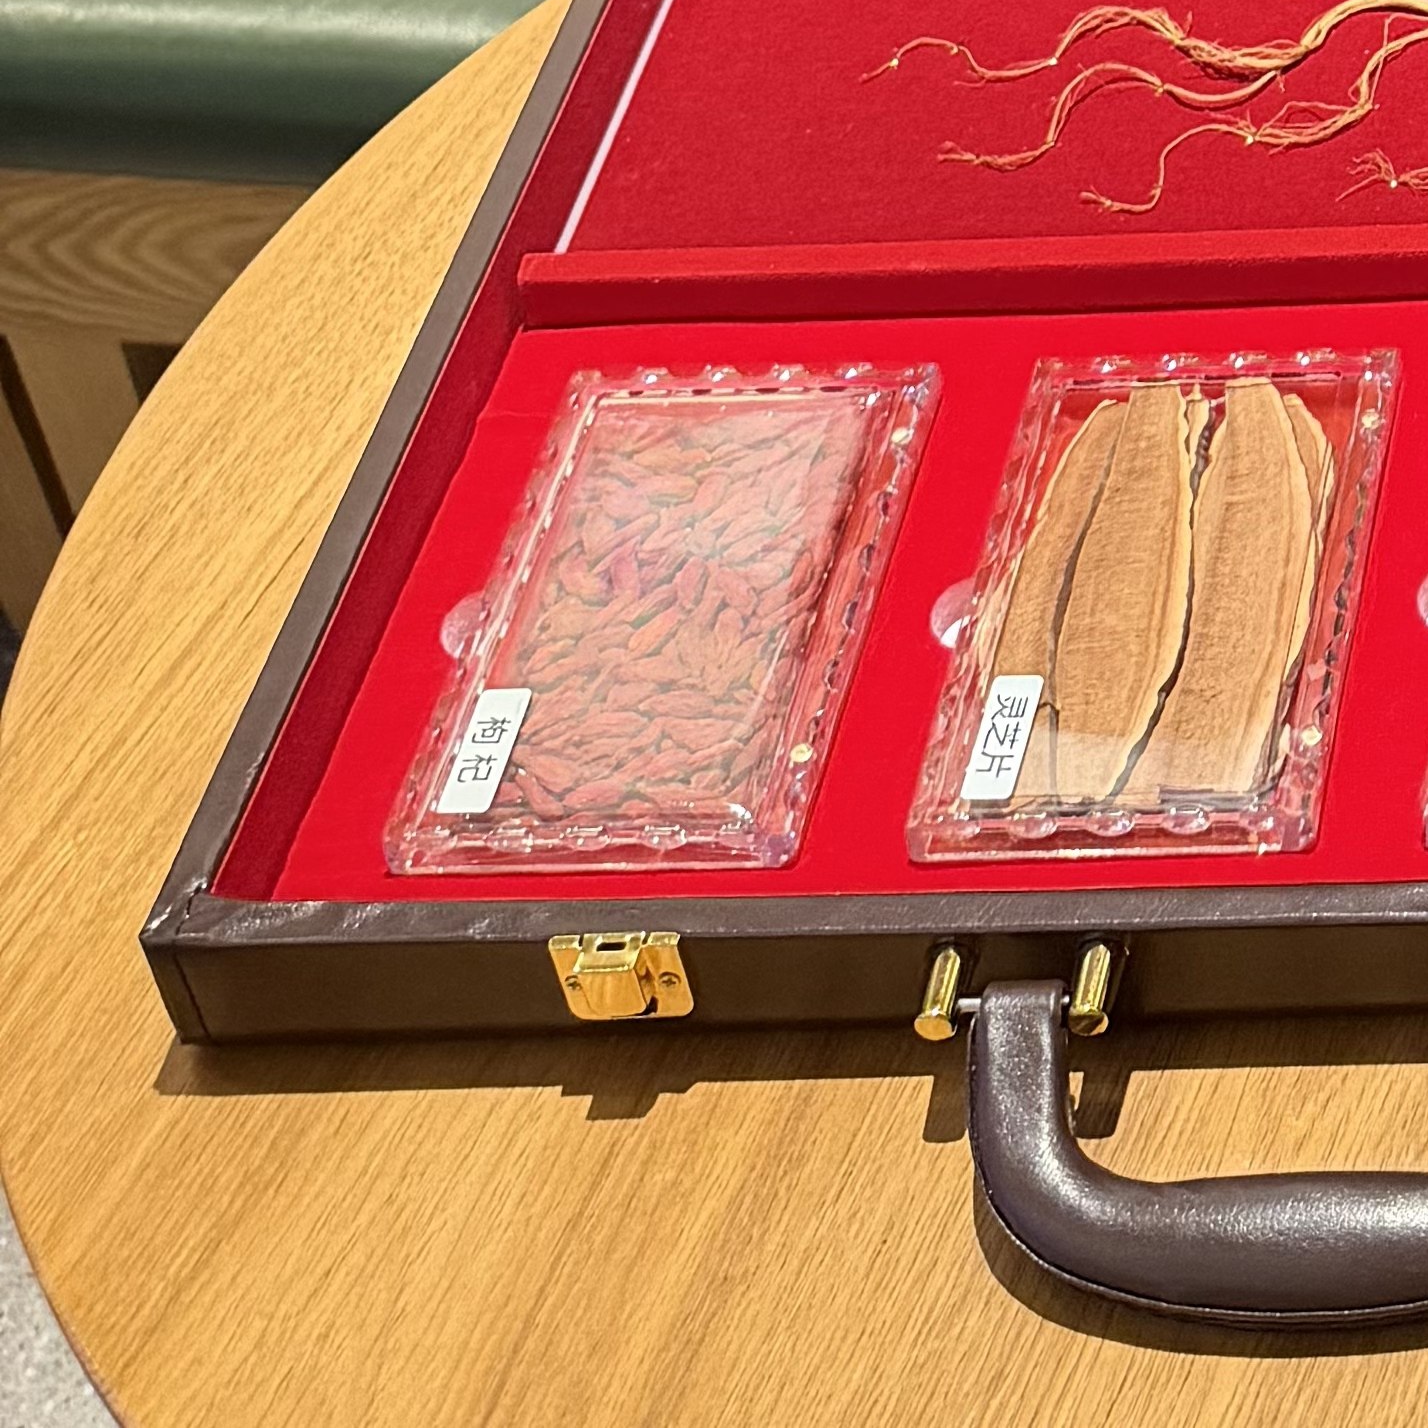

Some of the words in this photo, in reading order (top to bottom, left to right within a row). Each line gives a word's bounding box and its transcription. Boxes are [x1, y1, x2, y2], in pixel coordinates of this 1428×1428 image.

[457, 716, 512, 783] 枸杞
[975, 694, 1029, 778] 灵芝片
